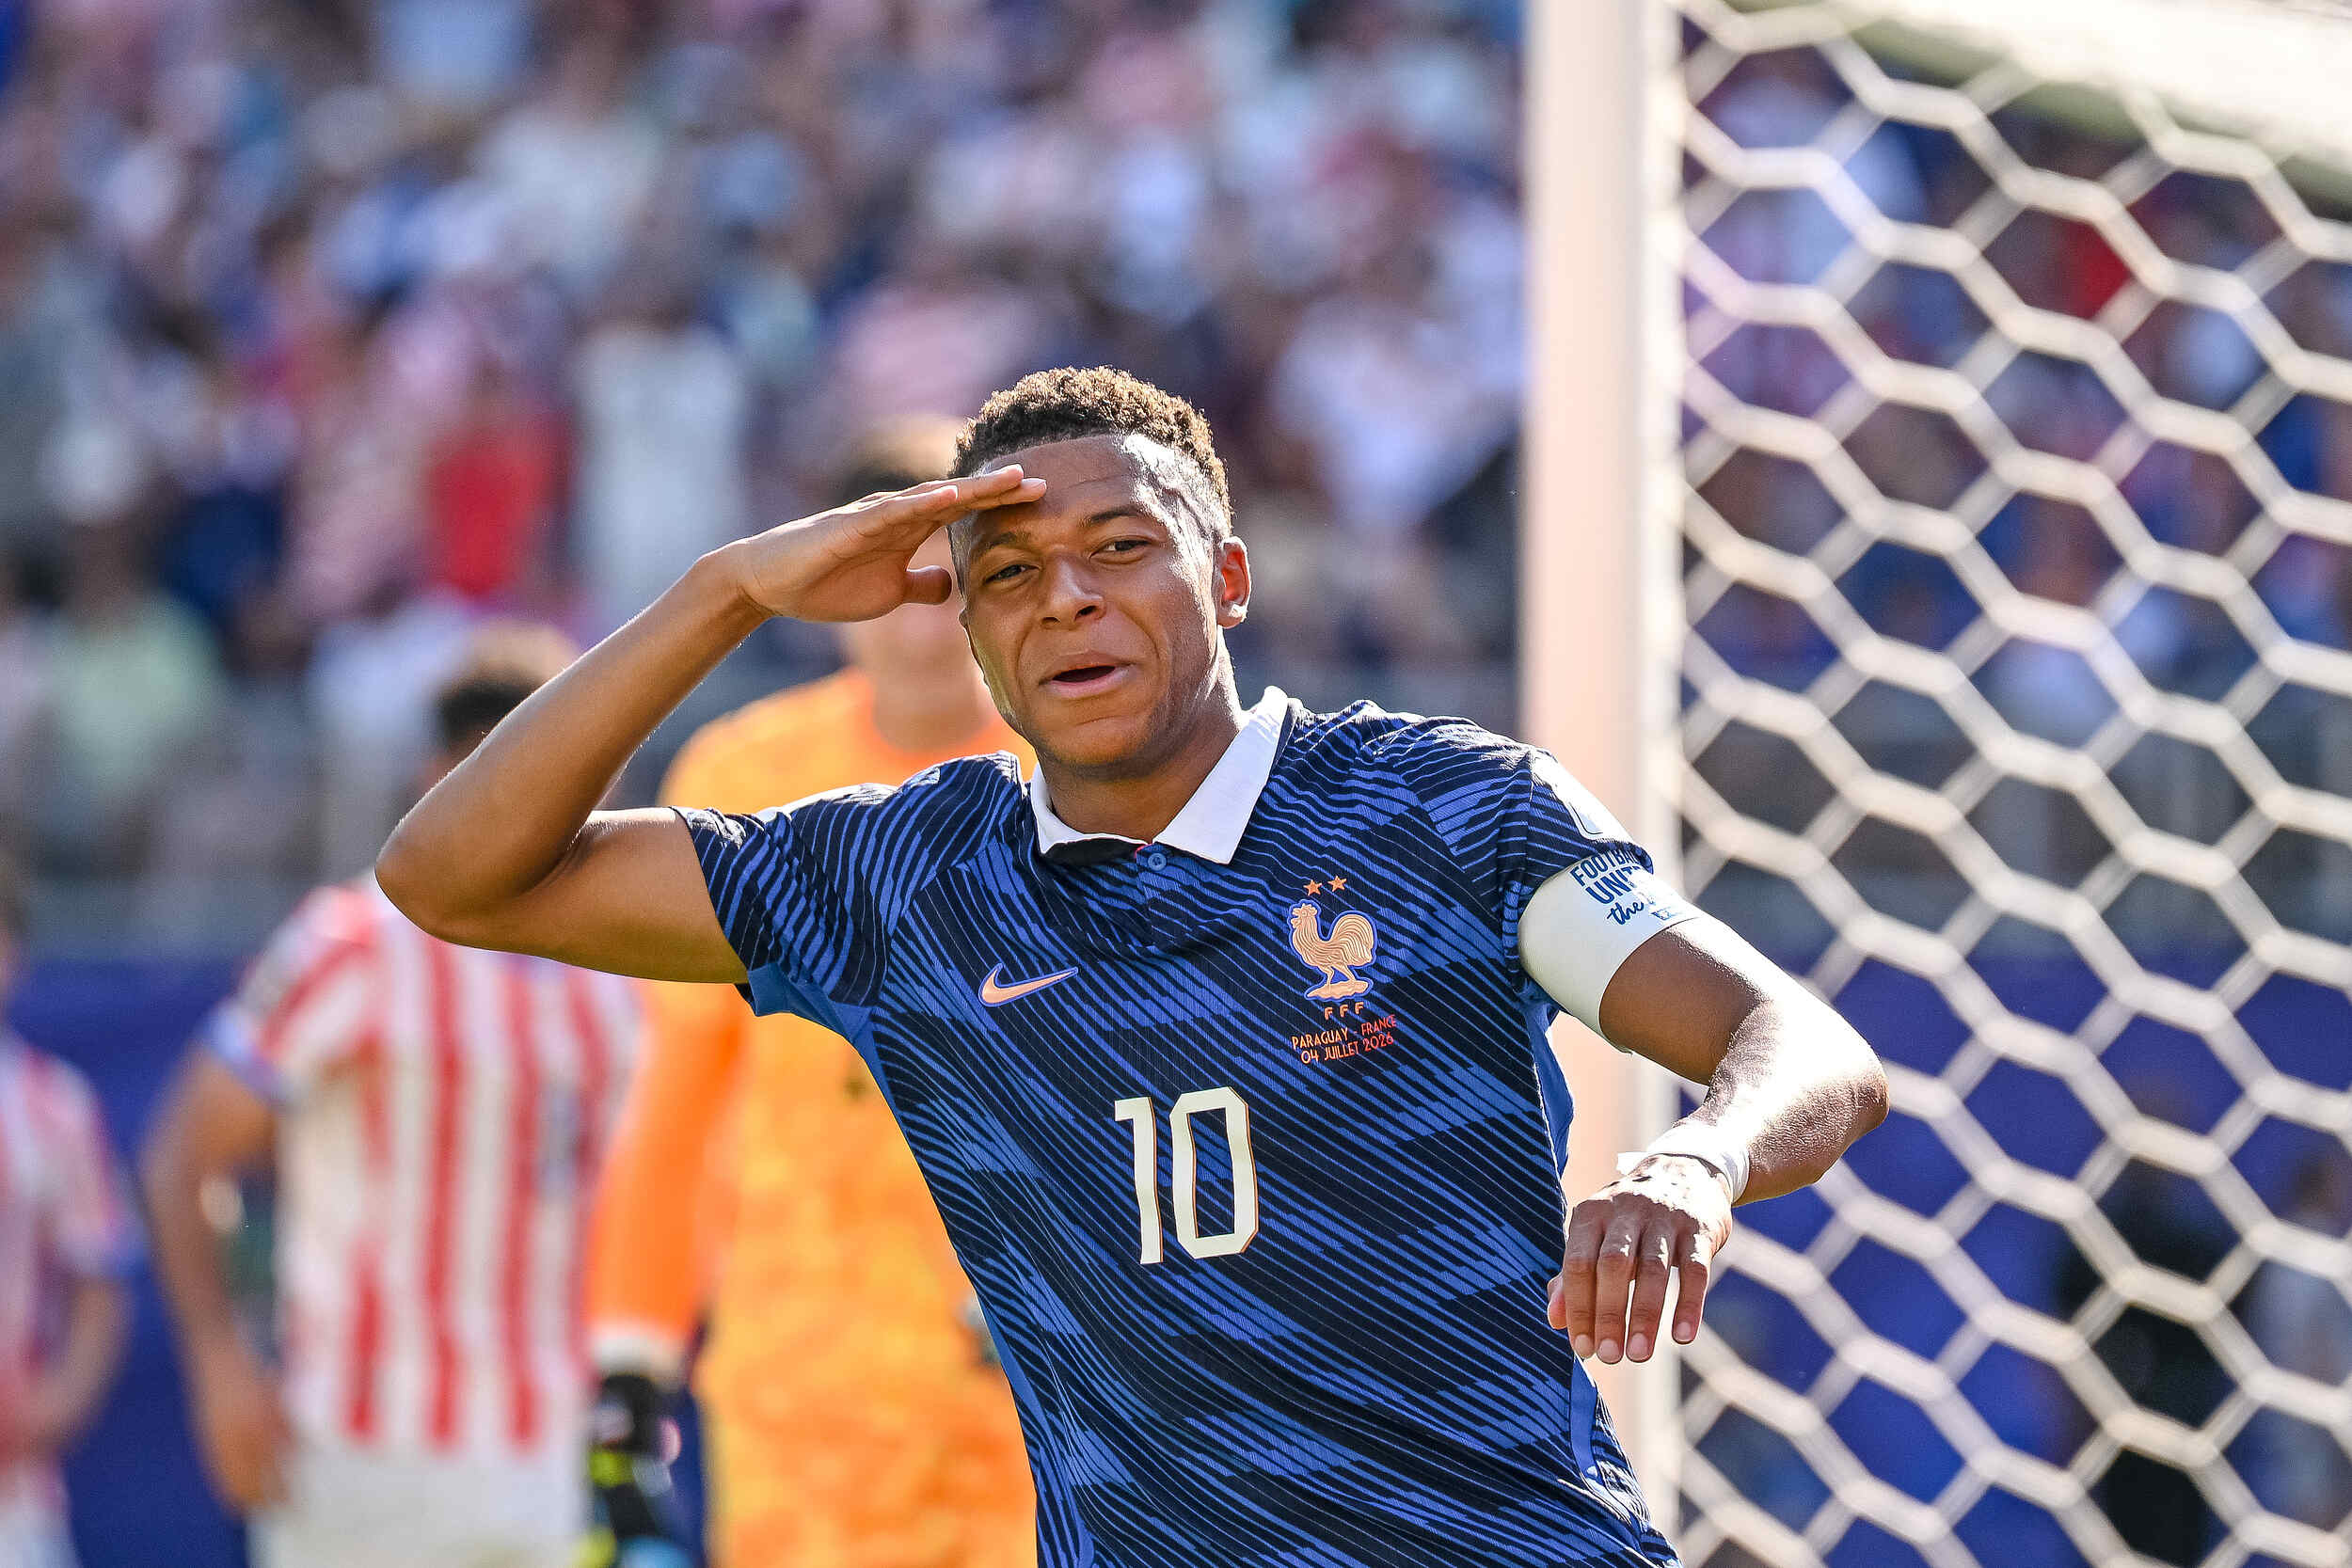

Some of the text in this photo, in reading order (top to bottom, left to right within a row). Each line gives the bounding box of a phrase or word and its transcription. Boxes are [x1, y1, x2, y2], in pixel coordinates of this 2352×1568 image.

[1569, 849, 1641, 886] FOOTBAL
[1607, 901, 1645, 925] the
[1291, 1027, 1348, 1051] PARAGUAY
[1360, 1014, 1396, 1037] FRANCE
[1300, 1031, 1394, 1064] 04 JUILLET 2026
[1114, 1085, 1259, 1264] 10
